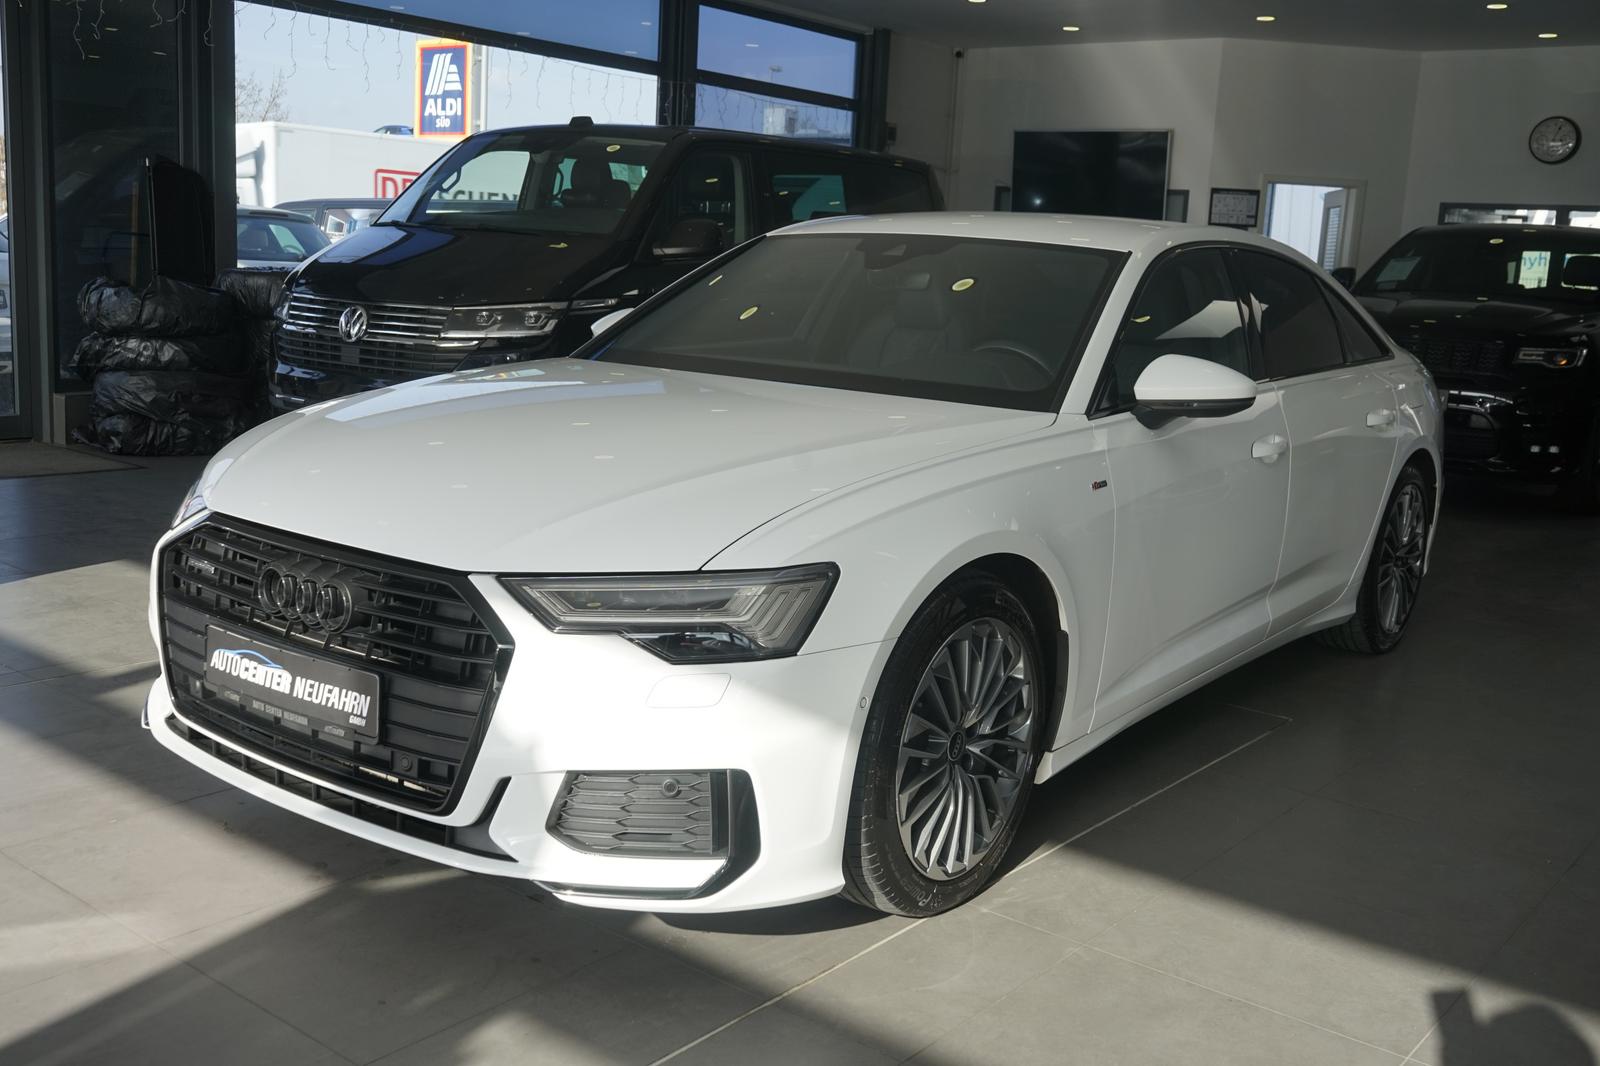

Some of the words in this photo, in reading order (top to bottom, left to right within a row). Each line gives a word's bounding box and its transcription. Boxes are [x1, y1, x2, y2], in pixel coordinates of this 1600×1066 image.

[424, 98, 462, 116] ALDI
[210, 650, 292, 694] AUTOCENTER
[293, 676, 371, 717] NEUFAHRN
